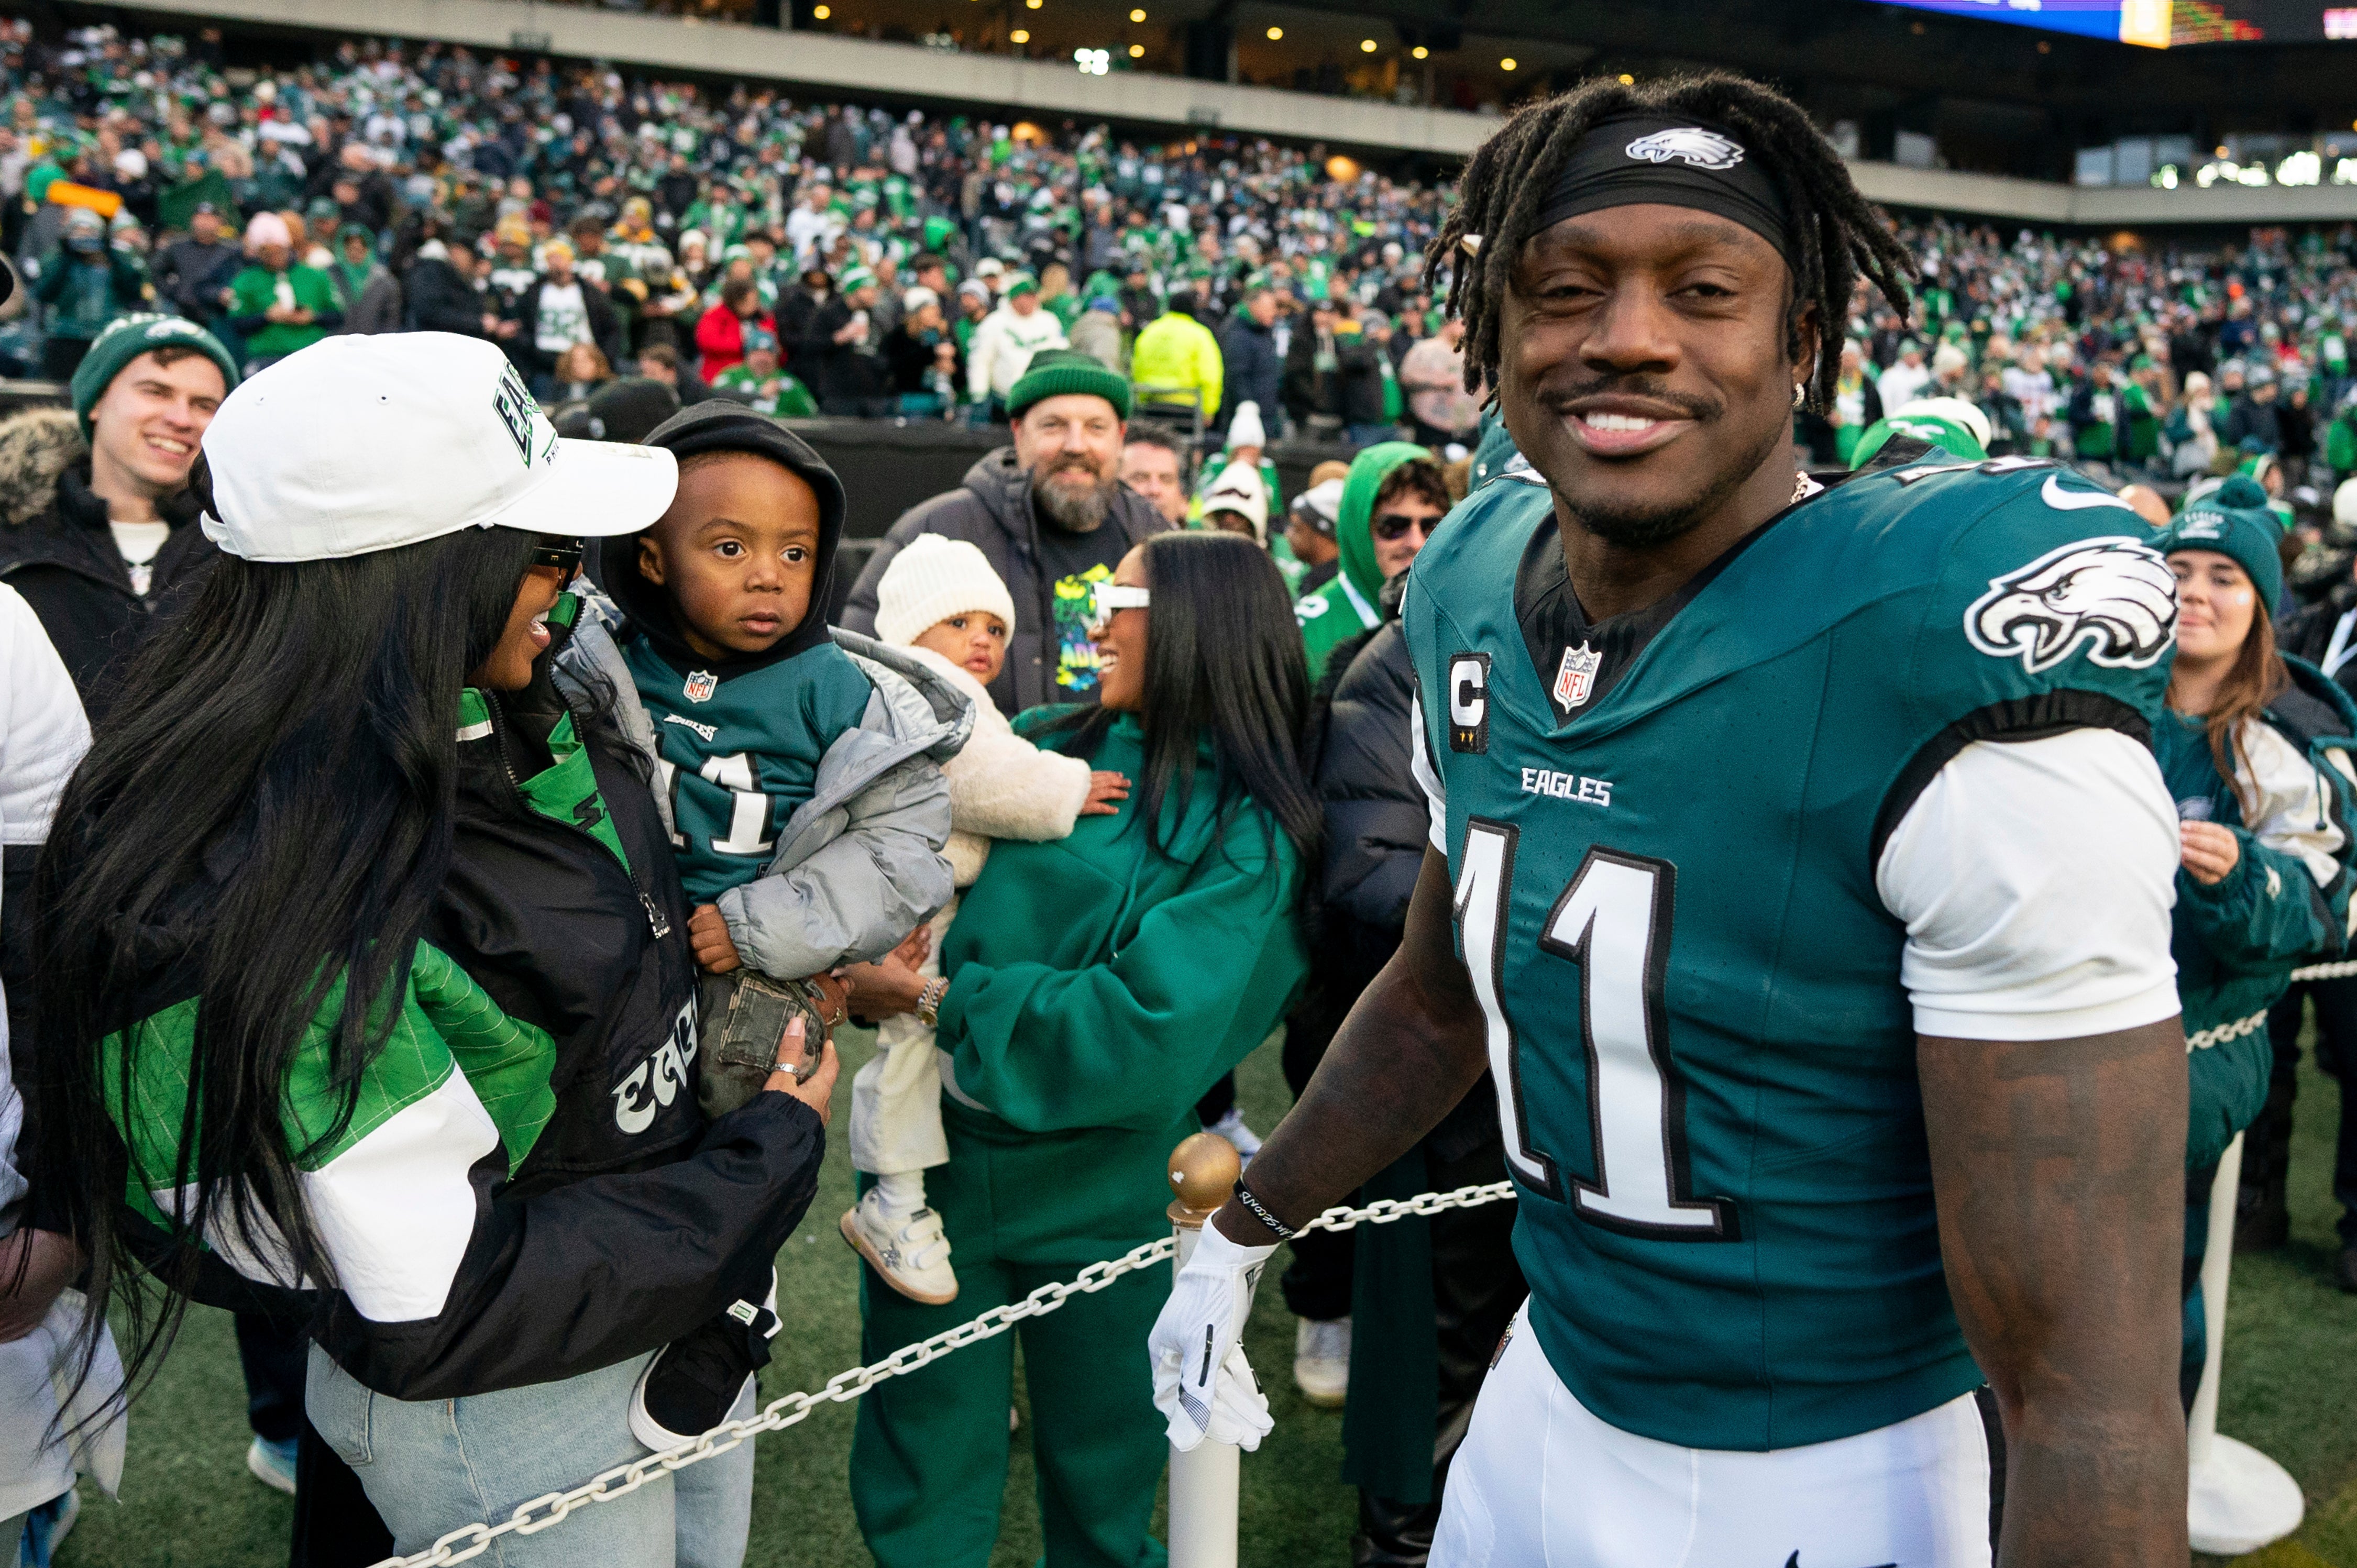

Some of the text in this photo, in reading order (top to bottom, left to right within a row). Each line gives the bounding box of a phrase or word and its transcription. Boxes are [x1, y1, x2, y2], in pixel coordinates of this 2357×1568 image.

[688, 682, 708, 698] NFL
[1450, 660, 1484, 726] C
[1561, 670, 1586, 698] NFL
[664, 713, 719, 742] EAGLES
[1521, 767, 1614, 807] EAGLES
[1453, 815, 1740, 1241] 11
[1242, 1191, 1280, 1226] SECOND
